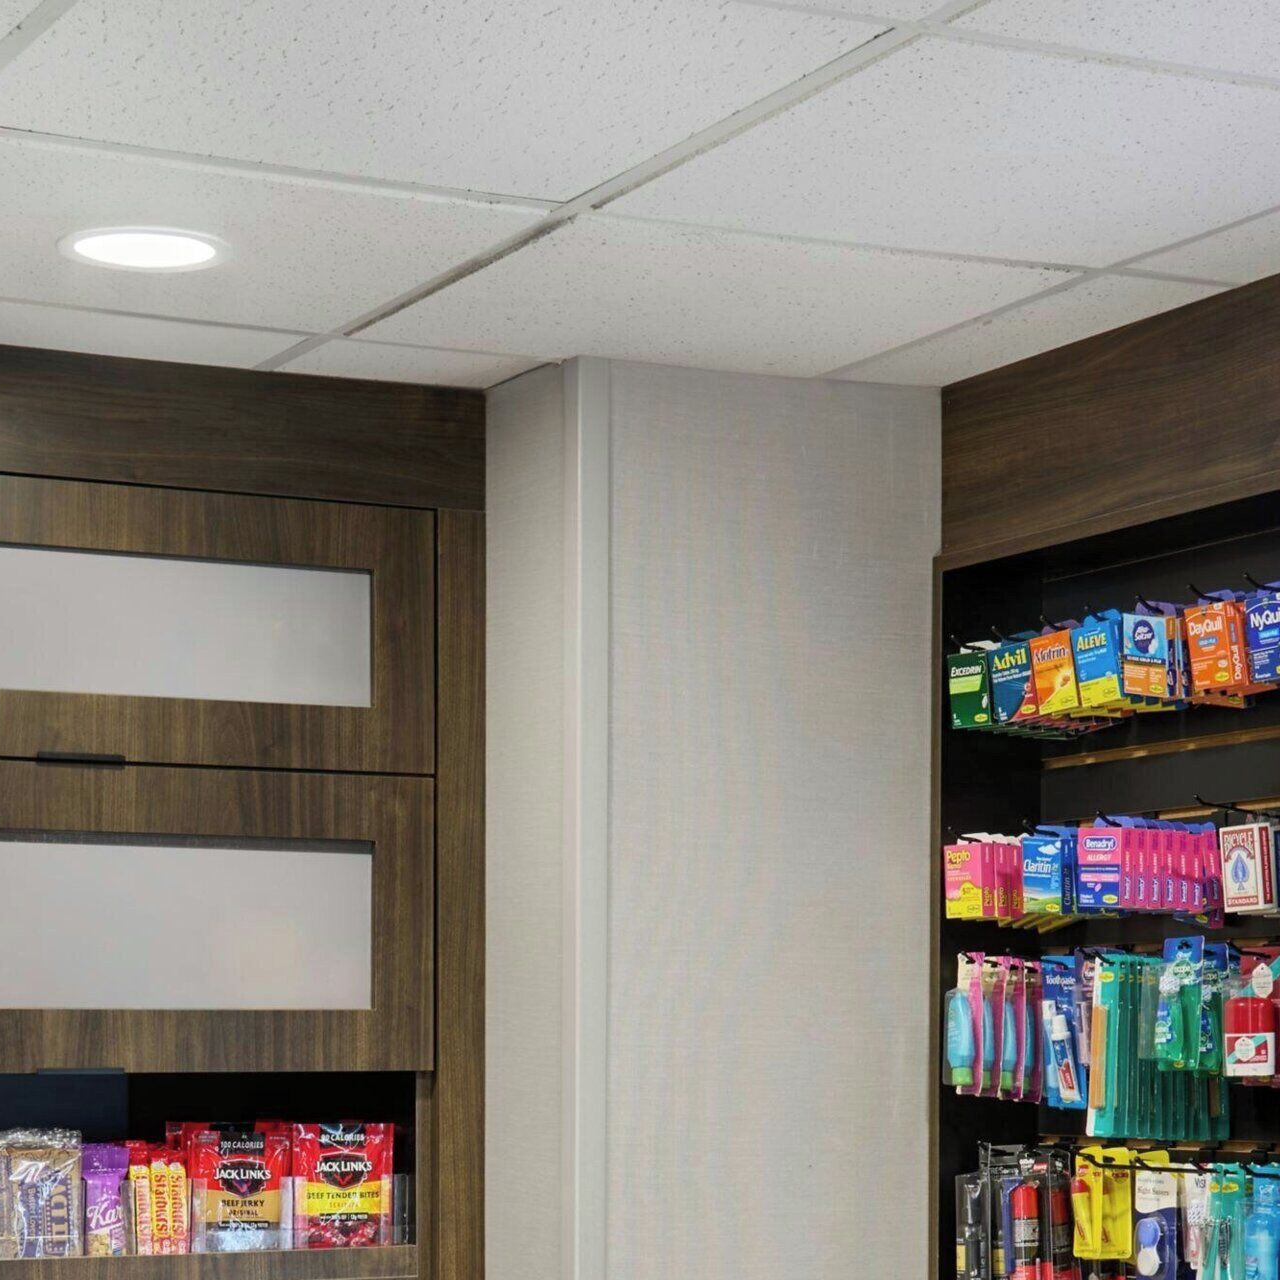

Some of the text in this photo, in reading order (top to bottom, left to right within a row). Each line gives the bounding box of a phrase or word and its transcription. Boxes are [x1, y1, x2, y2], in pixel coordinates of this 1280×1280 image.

[1188, 617, 1223, 637] DayQuil
[1076, 632, 1107, 651] ALEVE
[992, 647, 1027, 672] Advil
[1034, 645, 1067, 665] Motrin
[950, 665, 982, 678] EXCEDRIN
[1085, 838, 1115, 850] Benadryl
[946, 849, 970, 864] Pepto
[1023, 858, 1052, 873] Claritin
[232, 1140, 264, 1149] CALORIES
[214, 1167, 272, 1180] JACK LINK'S
[315, 1160, 373, 1173] JACK LINK'S
[306, 1192, 325, 1200] BEEF
[359, 1191, 380, 1199] BITES
